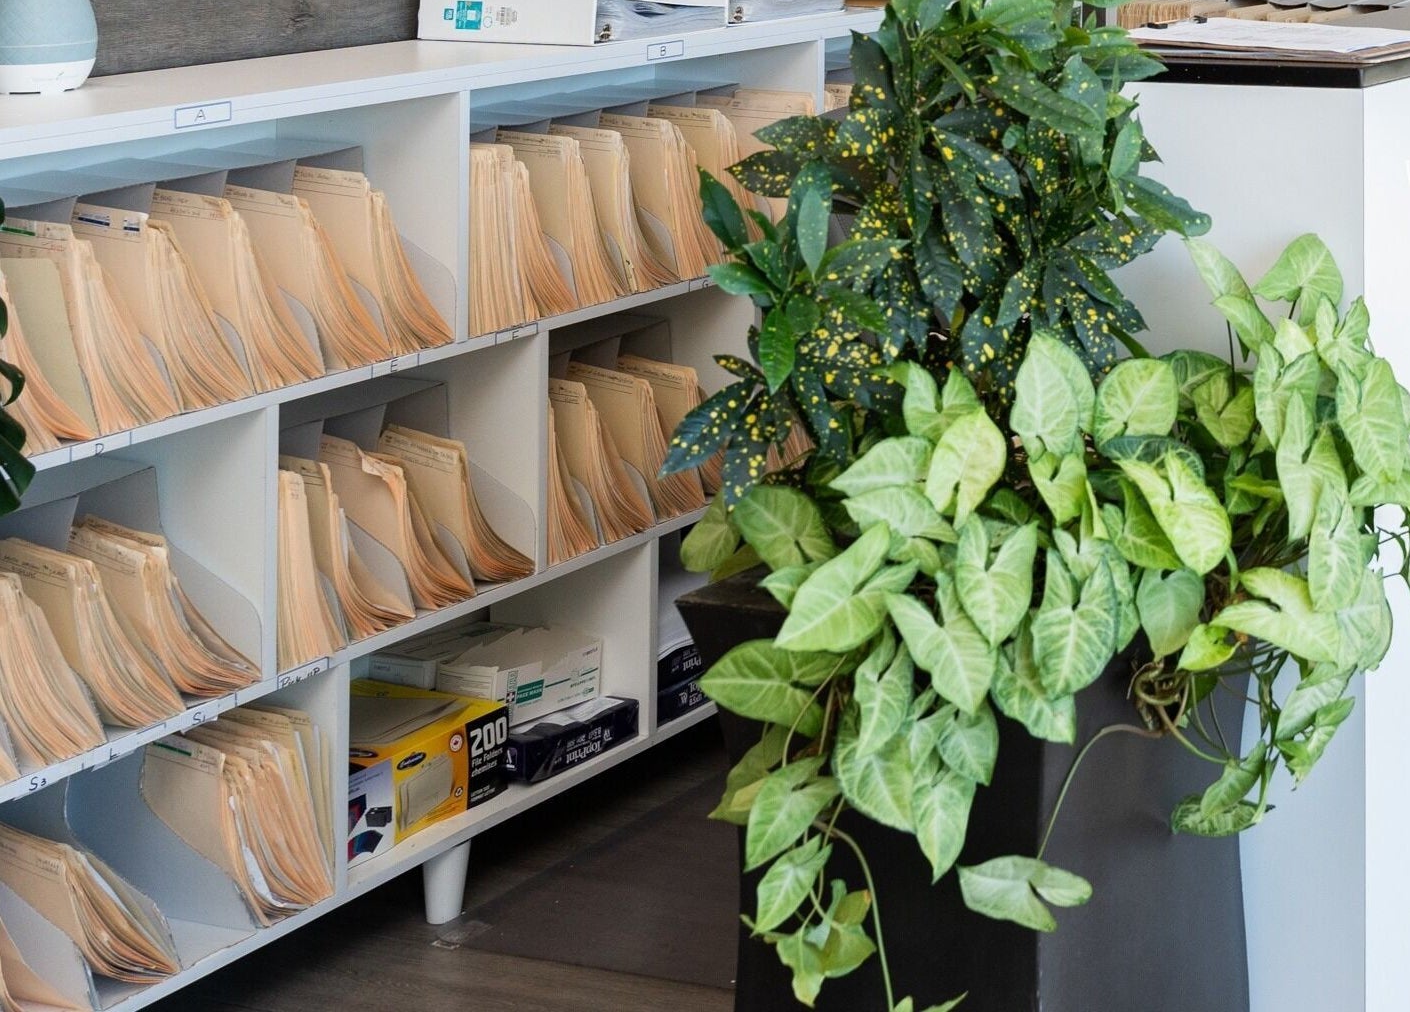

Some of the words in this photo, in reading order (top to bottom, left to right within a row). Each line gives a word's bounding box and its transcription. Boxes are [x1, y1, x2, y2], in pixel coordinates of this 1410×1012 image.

[194, 109, 206, 122] A
[469, 715, 508, 759] 200
[471, 756, 483, 768] File
[483, 746, 504, 762] Folders
[471, 758, 498, 778] chemises
